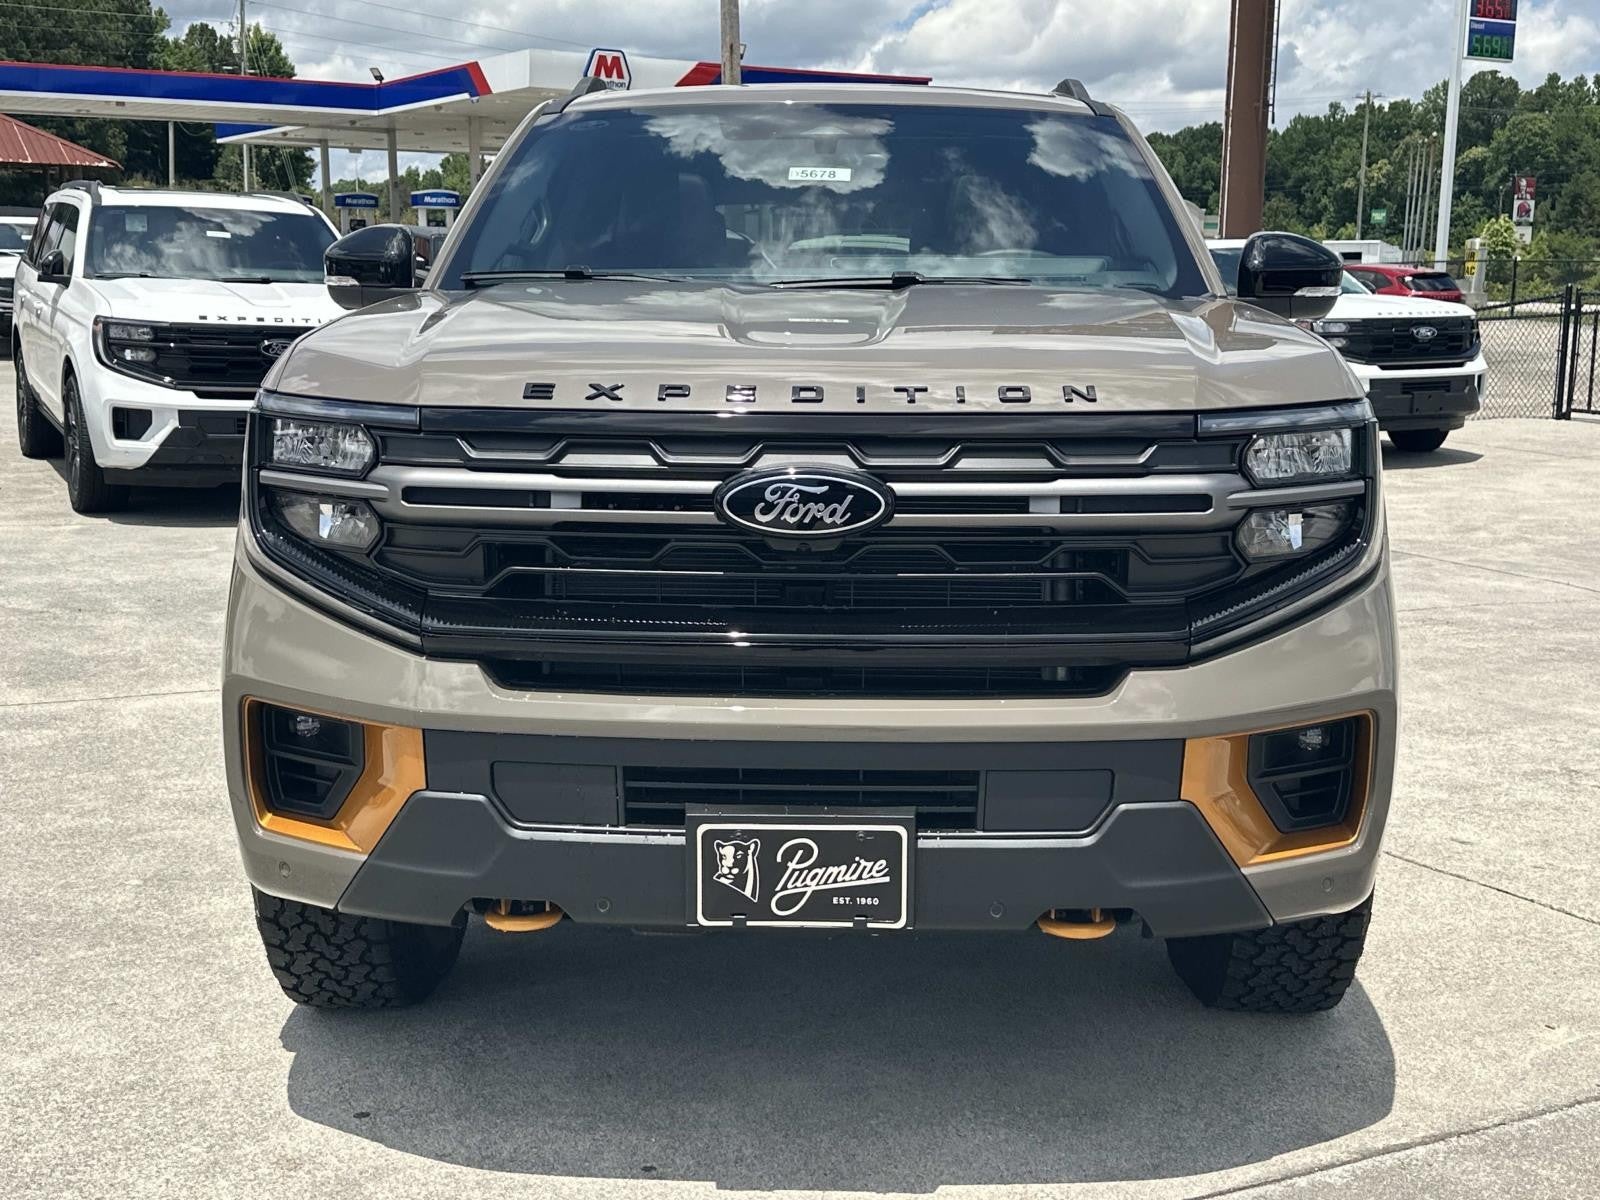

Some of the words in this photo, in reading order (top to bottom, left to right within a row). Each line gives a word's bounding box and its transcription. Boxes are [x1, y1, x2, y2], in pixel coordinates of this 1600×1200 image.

[593, 54, 624, 80] M
[424, 196, 456, 204] Marathon
[522, 382, 1098, 404] EXPEDITION
[754, 482, 854, 524] Ford
[770, 837, 891, 916] Pugmire
[832, 896, 853, 905] EST.
[856, 896, 880, 906] 1960
